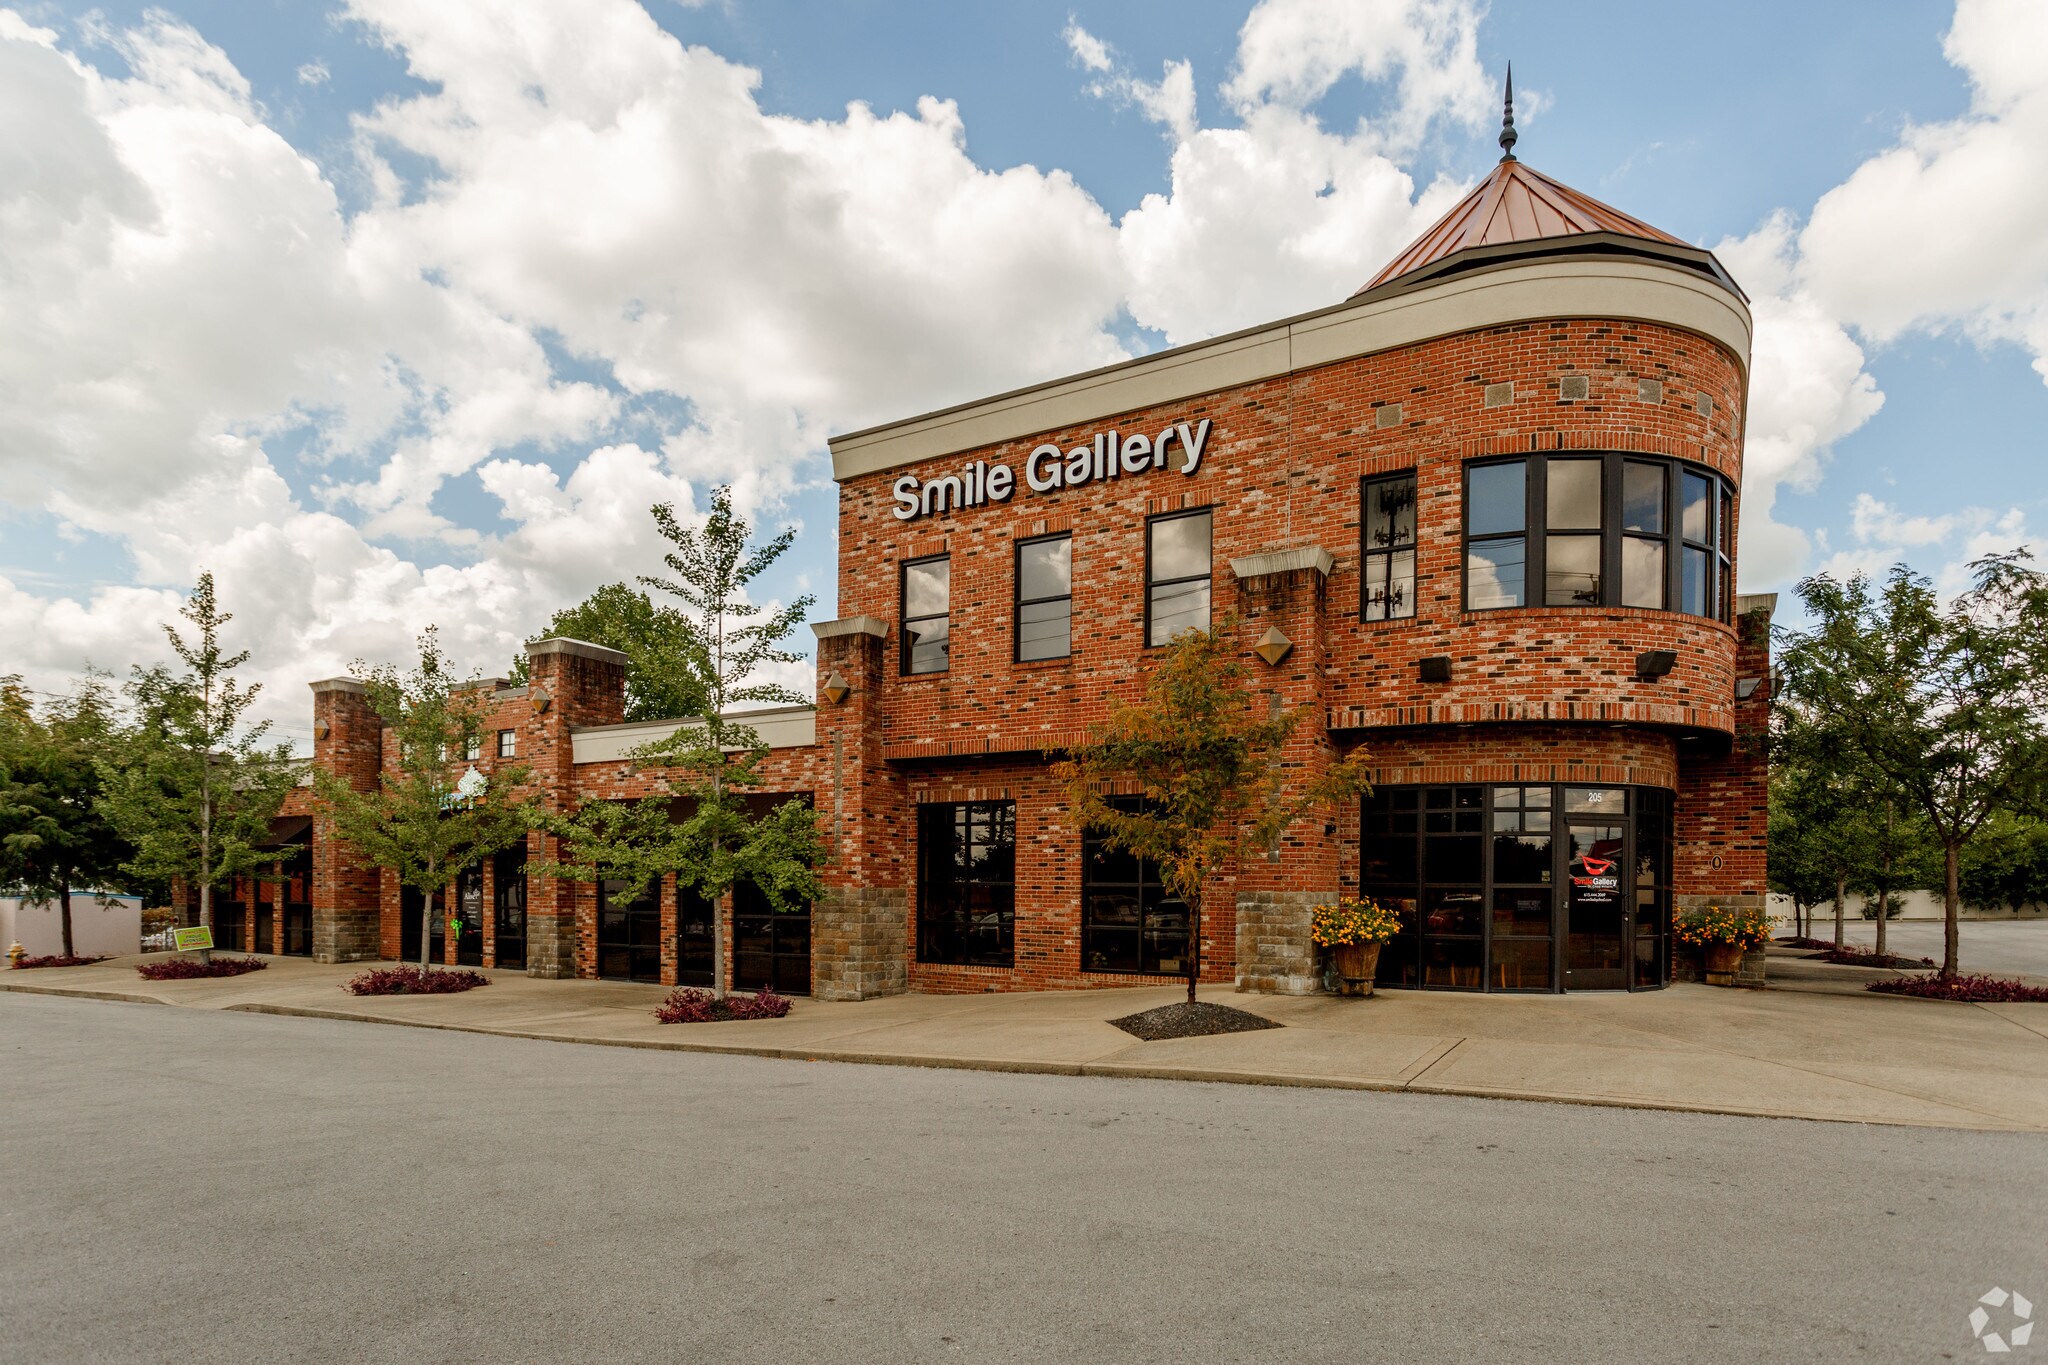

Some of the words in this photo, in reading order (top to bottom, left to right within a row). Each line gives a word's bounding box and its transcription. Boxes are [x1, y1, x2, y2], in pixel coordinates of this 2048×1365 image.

[893, 460, 1015, 521] Smile
[1026, 418, 1213, 493] Gallery
[1588, 792, 1602, 802] 205
